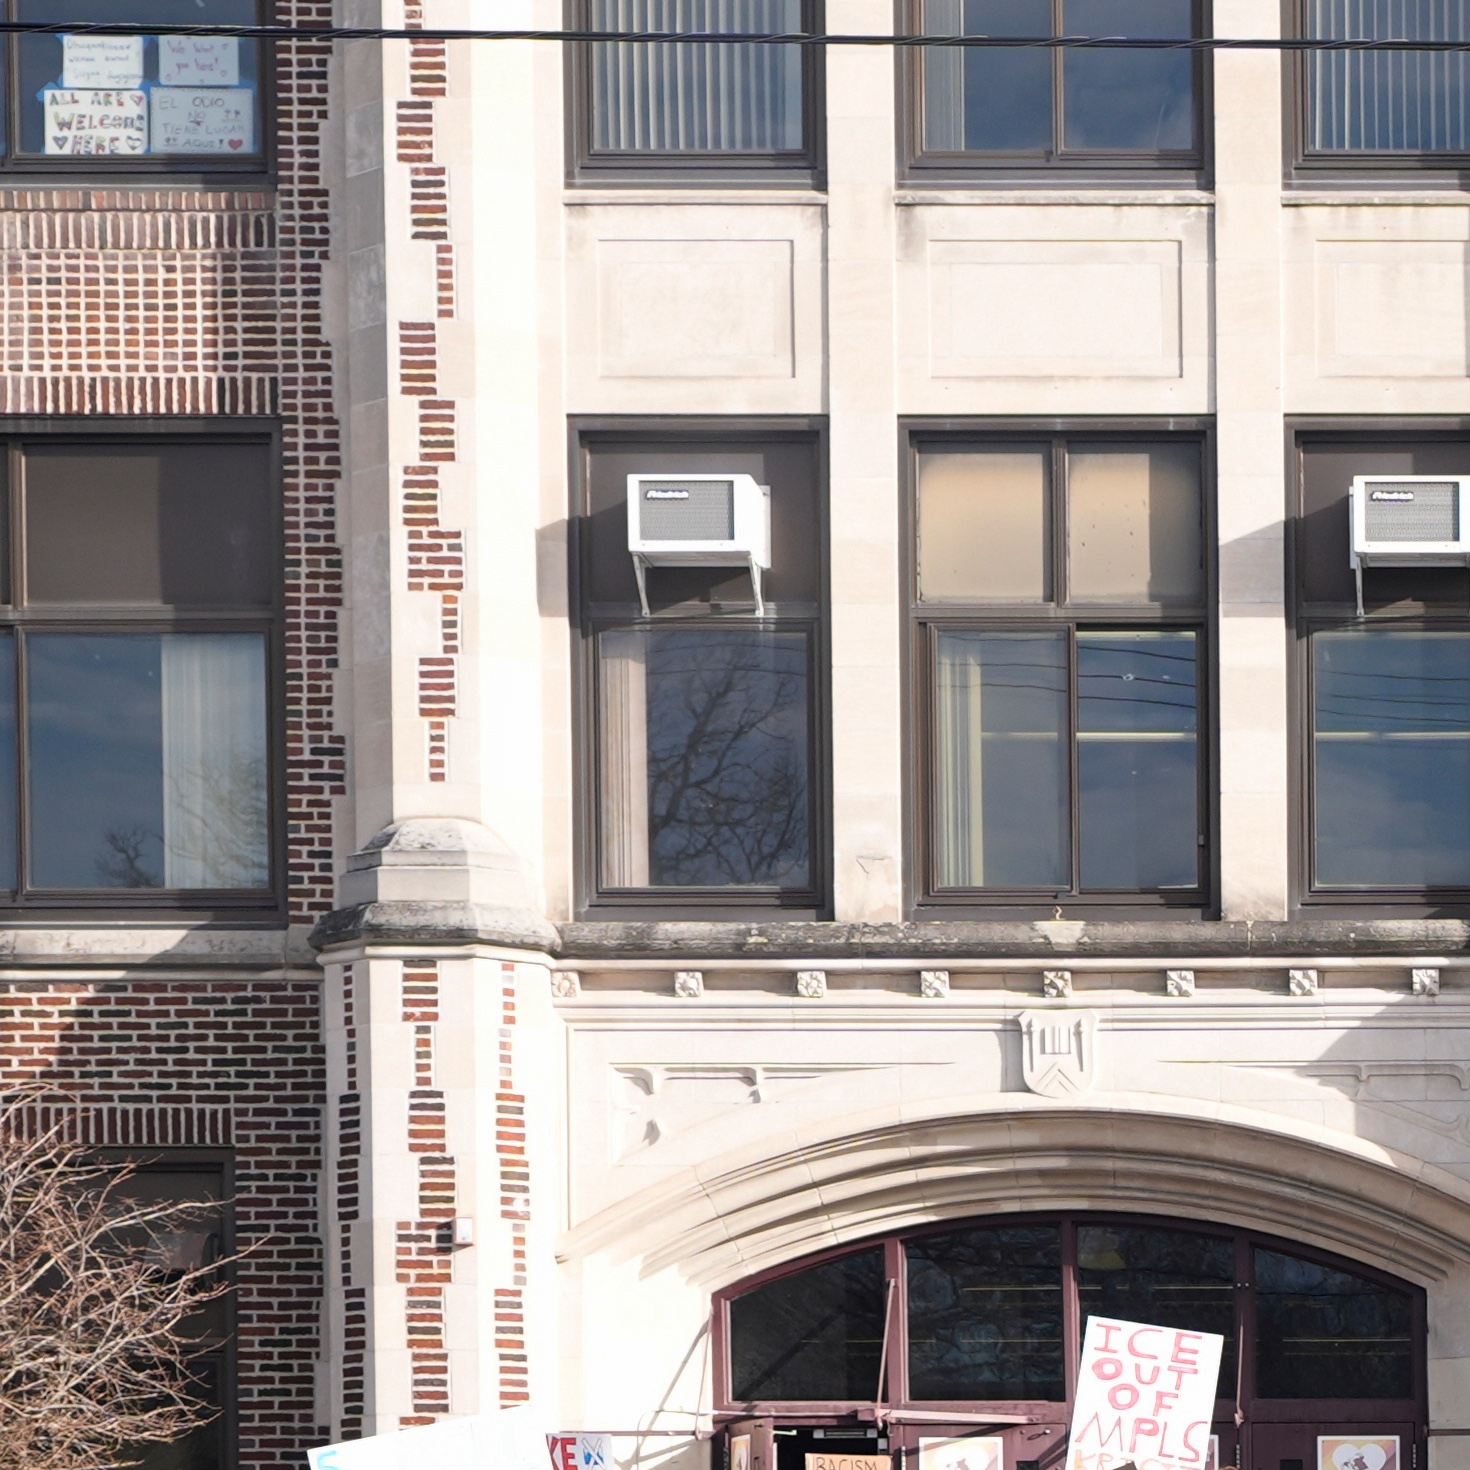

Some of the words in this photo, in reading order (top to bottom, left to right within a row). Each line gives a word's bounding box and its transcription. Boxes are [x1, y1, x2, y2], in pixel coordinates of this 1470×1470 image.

[50, 93, 80, 106] ALL
[91, 92, 124, 107] ARE
[159, 96, 179, 110] EL
[53, 112, 145, 132] WELCOME
[70, 134, 121, 155] HERE
[1093, 1322, 1203, 1366] ICE
[1091, 1357, 1199, 1391] OUT
[1107, 1383, 1180, 1417] OF
[1074, 1411, 1209, 1463] MPLS
